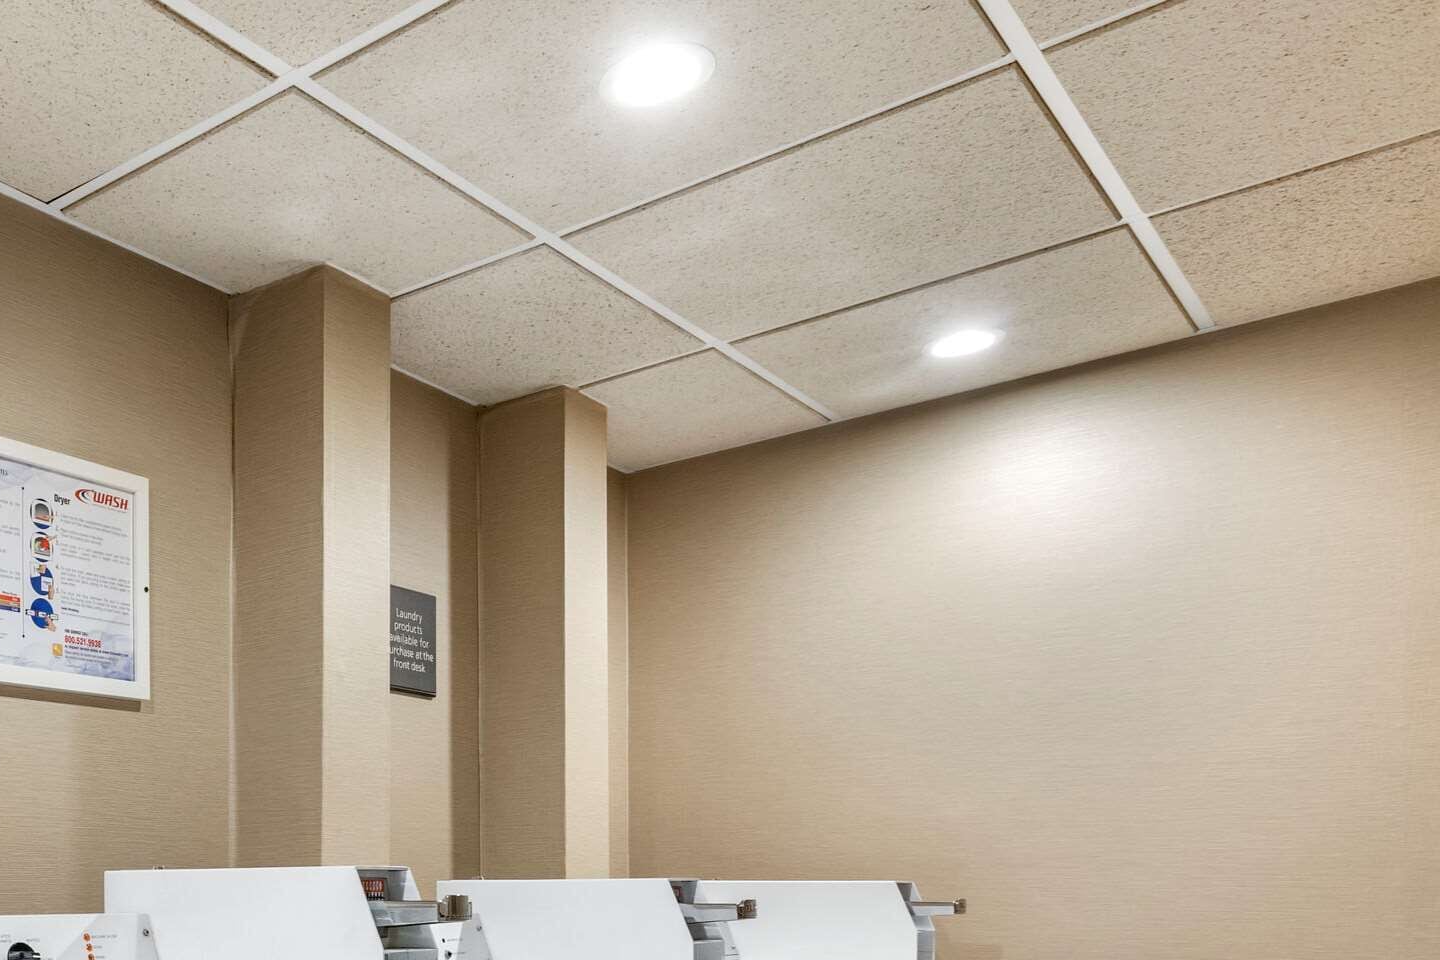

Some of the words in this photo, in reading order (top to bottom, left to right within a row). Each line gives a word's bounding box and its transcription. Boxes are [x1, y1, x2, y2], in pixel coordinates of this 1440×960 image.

[54, 493, 71, 506] Dryer
[92, 491, 129, 511] WASH
[396, 607, 423, 624] Laundry
[394, 621, 423, 635] products
[420, 637, 430, 649] for
[389, 646, 415, 658] urchase
[415, 651, 422, 659] at
[423, 651, 434, 662] the
[393, 658, 410, 670] front
[410, 662, 426, 673] desk
